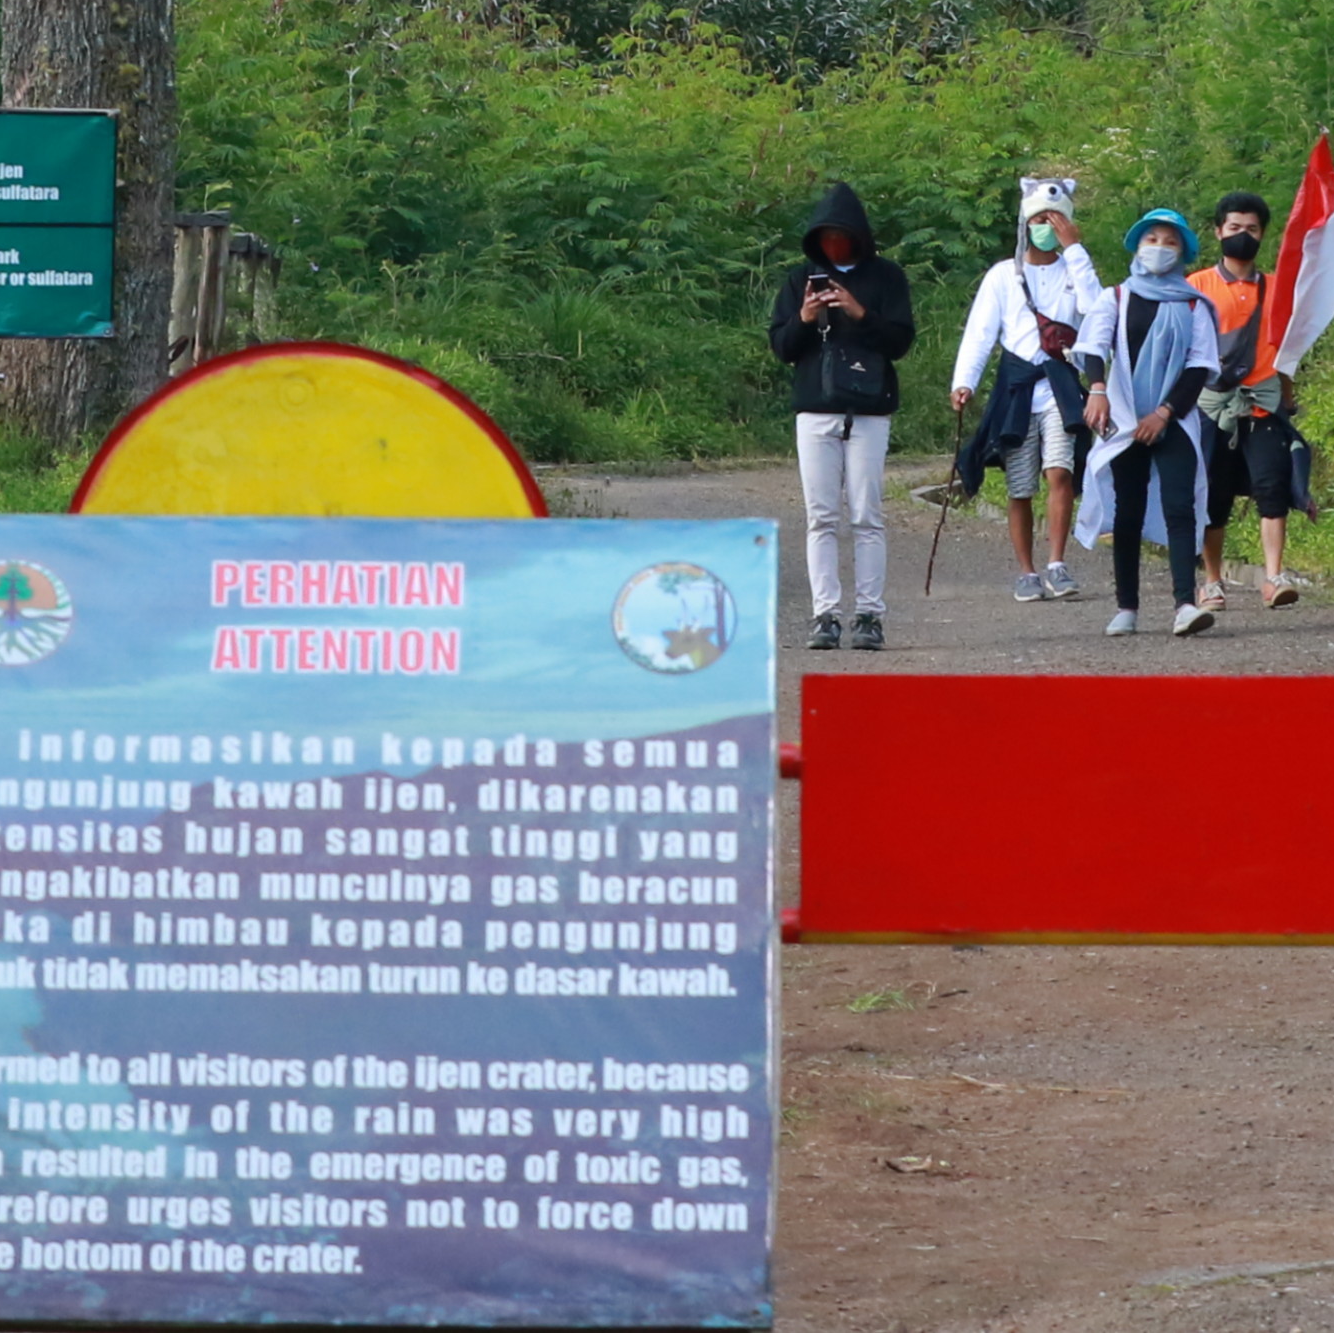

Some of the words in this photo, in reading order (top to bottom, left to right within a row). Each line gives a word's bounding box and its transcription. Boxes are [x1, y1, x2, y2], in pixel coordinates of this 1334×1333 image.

[9, 272, 25, 285] or
[27, 270, 93, 285] sulfatara
[211, 559, 466, 609] PERHATIAN
[211, 625, 462, 675] ATTENTION
[17, 729, 357, 764] informasikan
[380, 732, 558, 768] kepada
[583, 738, 740, 768] semua
[213, 776, 343, 809] kawah
[364, 778, 457, 813] ijen,
[477, 779, 739, 813] dikarenakan
[184, 821, 304, 857] hujan
[325, 825, 470, 859] sangat
[489, 824, 618, 862] tinggi
[638, 830, 739, 862] yang
[259, 869, 472, 904] munculnya
[490, 875, 560, 907] gas
[578, 871, 738, 904] beracun
[71, 911, 112, 944] di
[133, 911, 289, 946] himbau
[310, 913, 464, 950] kepada
[484, 917, 742, 954] pengunjung
[42, 957, 129, 990] tidak
[134, 959, 362, 993] memaksakan
[368, 962, 461, 994] turun
[466, 961, 509, 995] ke
[514, 962, 613, 996] dasar
[618, 963, 737, 996] kawah.
[86, 1054, 121, 1085] to
[127, 1053, 172, 1085] all
[177, 1053, 307, 1087] visitors
[312, 1055, 347, 1087] of
[352, 1055, 409, 1088] the
[487, 1059, 597, 1092] crater,
[602, 1057, 750, 1092] because
[6, 1097, 191, 1135] intensity
[210, 1100, 250, 1133] of
[269, 1100, 335, 1134] the
[353, 1101, 436, 1135] rain
[455, 1108, 534, 1136] was
[552, 1108, 641, 1140] very
[659, 1105, 750, 1142] high
[21, 1145, 167, 1178] resulted
[184, 1146, 218, 1179] in
[235, 1146, 293, 1180] the
[309, 1152, 507, 1184] emergence
[524, 1150, 559, 1183] of
[575, 1150, 661, 1184] toxic
[678, 1156, 748, 1189] gas,
[126, 1196, 233, 1229] urges
[248, 1193, 388, 1227] visitors
[405, 1197, 466, 1228] not
[482, 1197, 520, 1228] to
[537, 1196, 634, 1230] force
[650, 1197, 749, 1231] down
[21, 1237, 143, 1271] bottom
[149, 1239, 184, 1272] of
[189, 1238, 246, 1273] the
[252, 1242, 363, 1274] crater.
